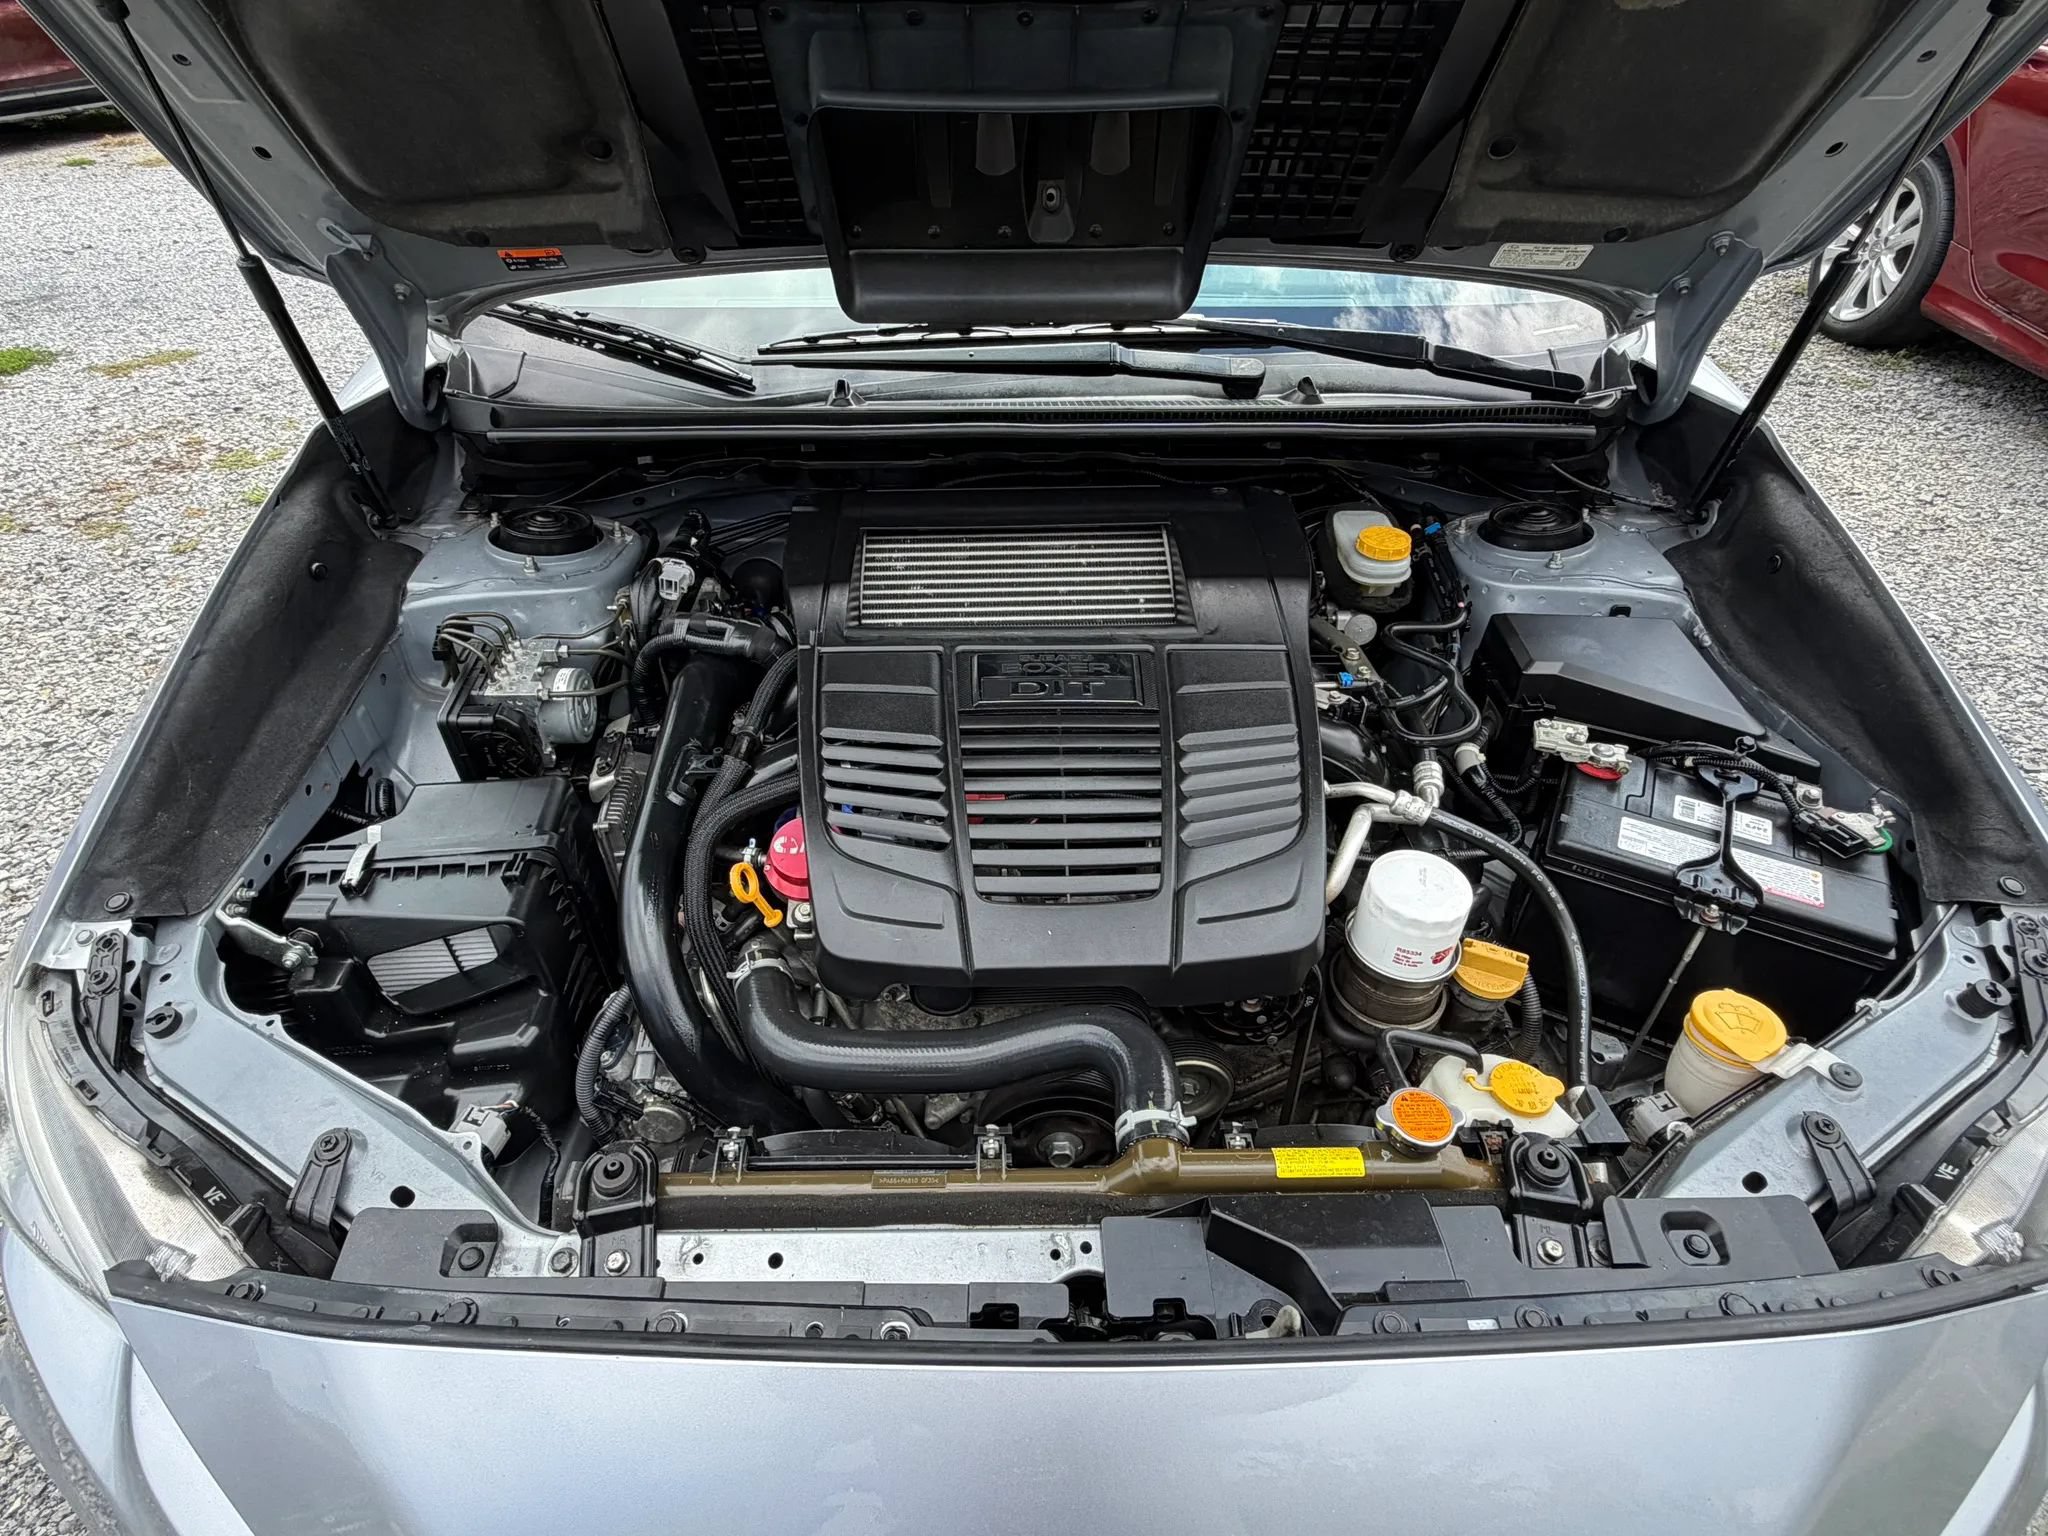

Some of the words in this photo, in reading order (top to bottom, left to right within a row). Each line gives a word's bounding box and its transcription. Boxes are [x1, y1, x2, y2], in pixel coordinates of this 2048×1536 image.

[1018, 654, 1095, 662] SUBARU
[1001, 662, 1112, 674] BOXER
[1010, 680, 1106, 697] DIT
[1934, 1162, 1960, 1180] VE
[203, 1186, 227, 1206] VE
